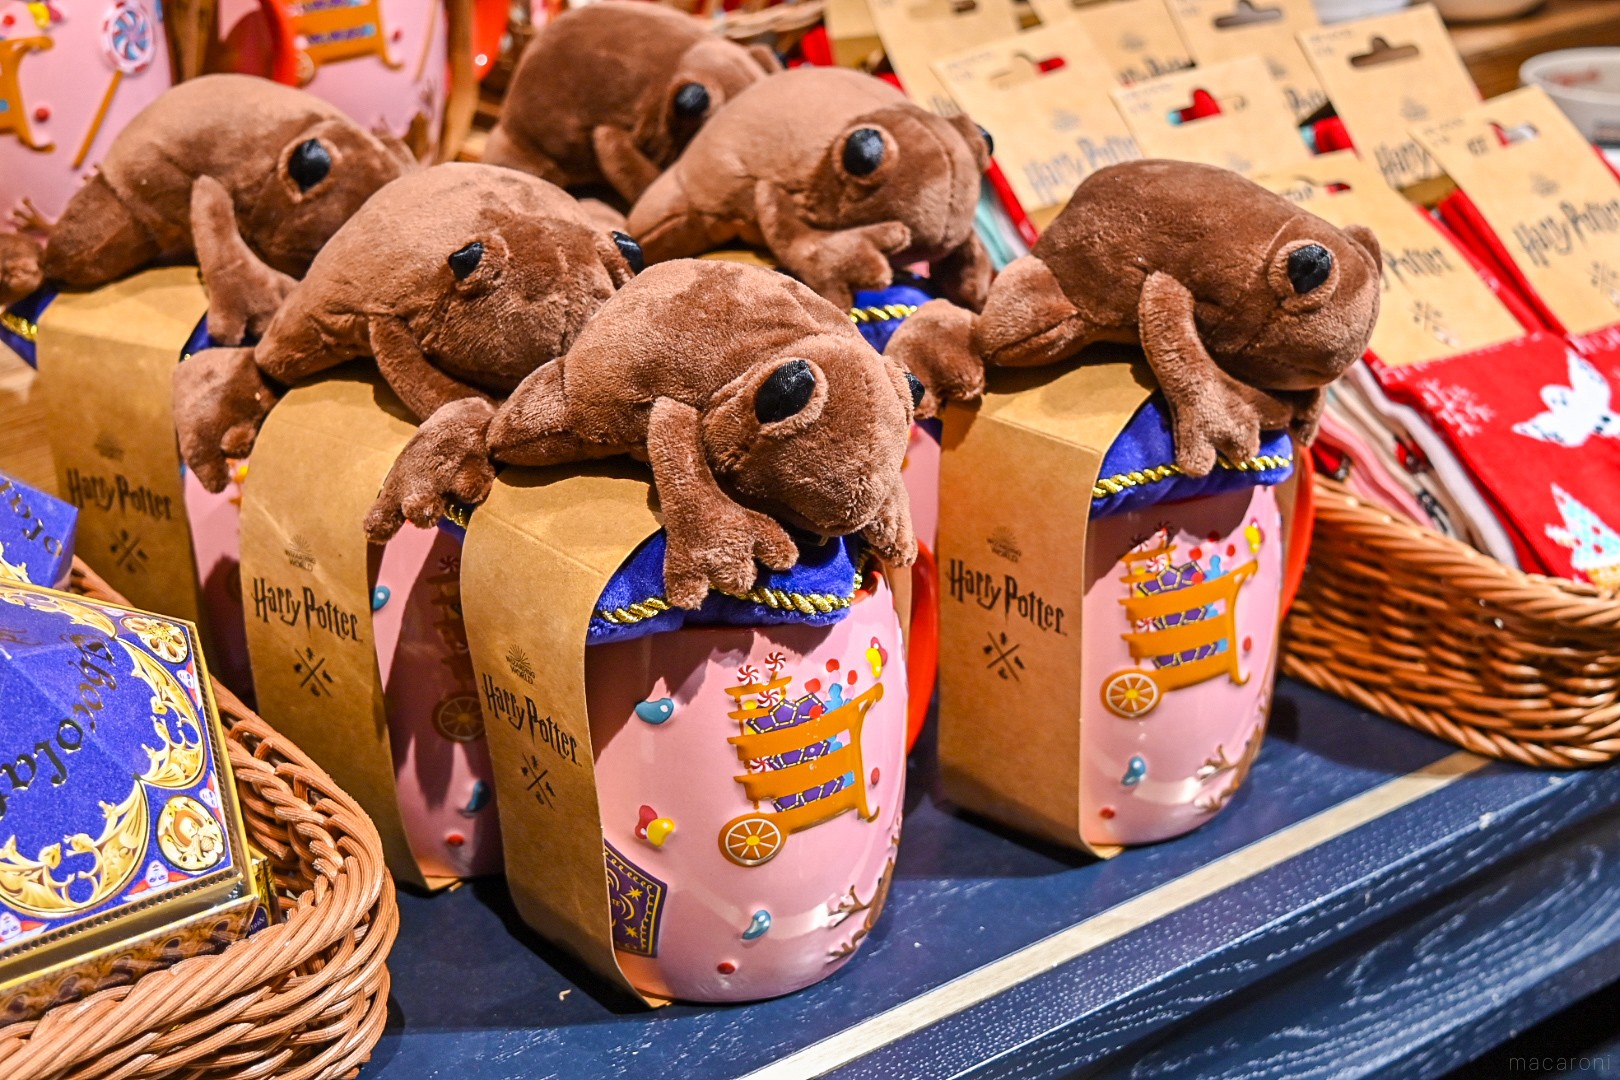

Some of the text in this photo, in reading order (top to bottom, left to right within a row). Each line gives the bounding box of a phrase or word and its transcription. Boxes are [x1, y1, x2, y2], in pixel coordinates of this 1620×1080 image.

[66, 467, 172, 521] Harry Potter
[251, 576, 359, 642] Harry Potter
[946, 558, 1065, 635] Harry Potter
[510, 665, 533, 685] WORLD
[482, 672, 578, 766] Harry Potter
